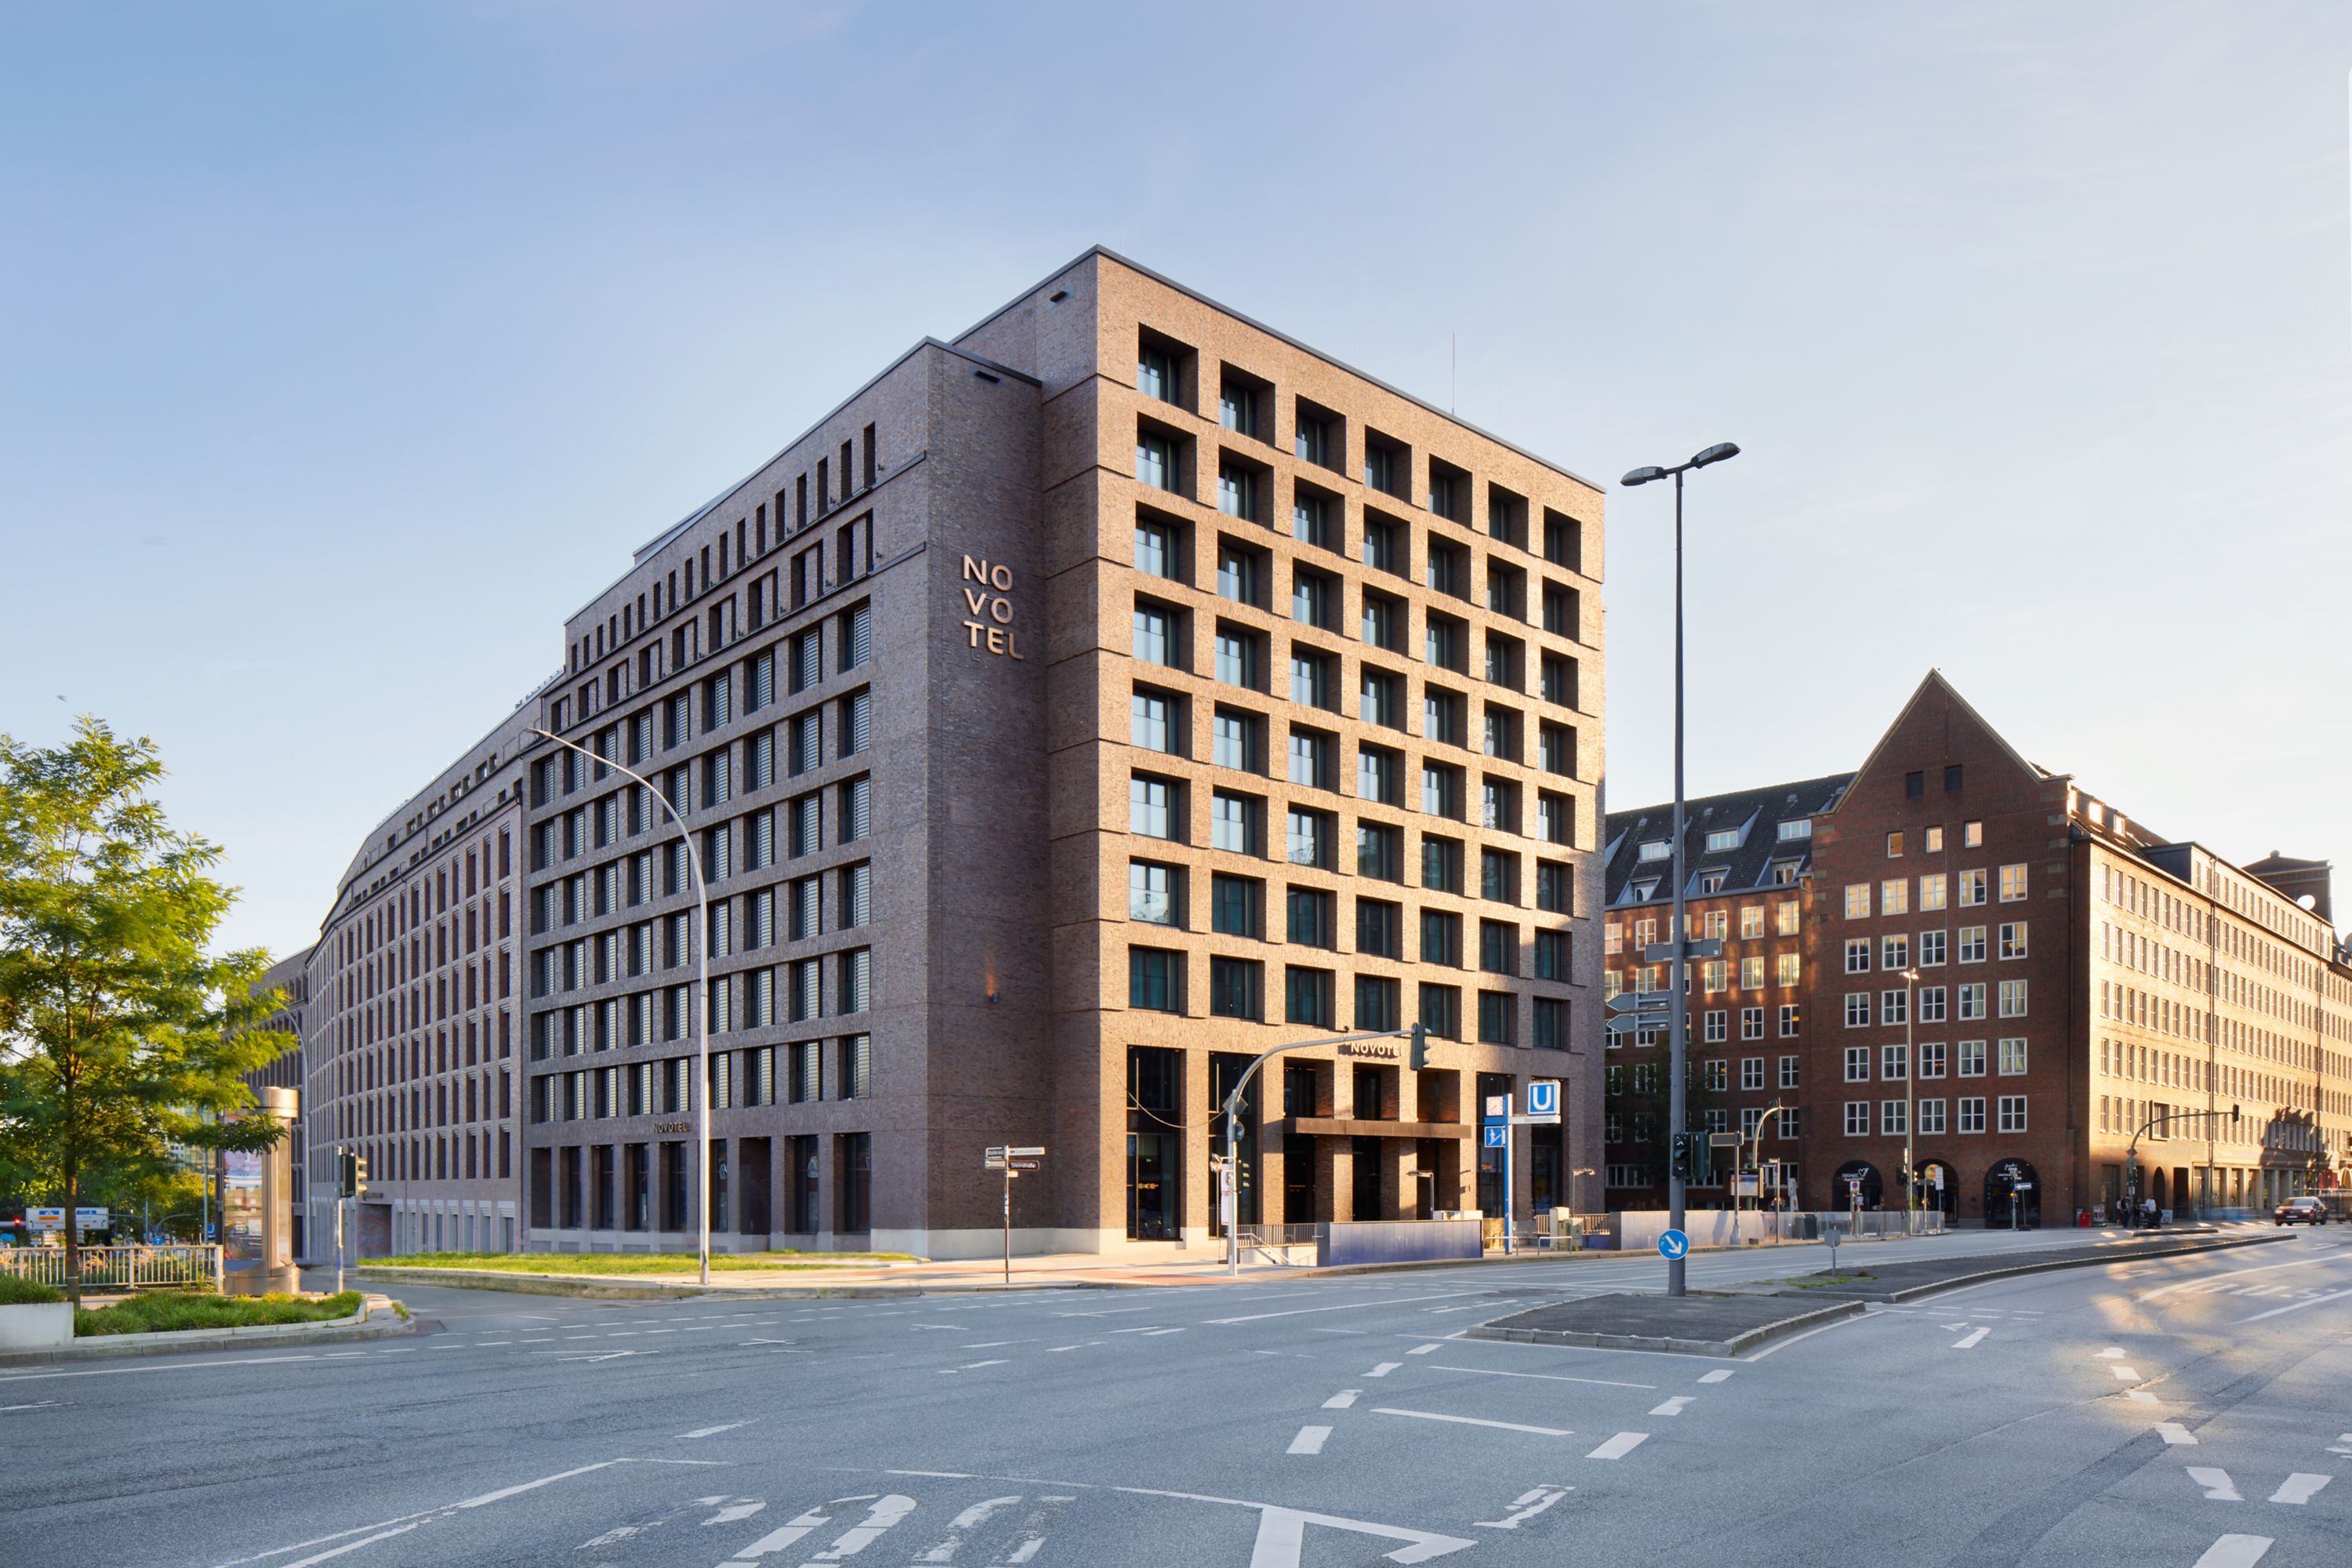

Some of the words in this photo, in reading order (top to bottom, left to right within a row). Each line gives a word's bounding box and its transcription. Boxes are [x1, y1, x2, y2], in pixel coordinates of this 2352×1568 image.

[963, 554, 1013, 591] NO
[963, 587, 1014, 624] VO
[962, 620, 1025, 660] TEL
[1350, 1041, 1406, 1057] NOVOTEL
[1532, 1085, 1552, 1111] U
[652, 1121, 688, 1133] NOVOTEL
